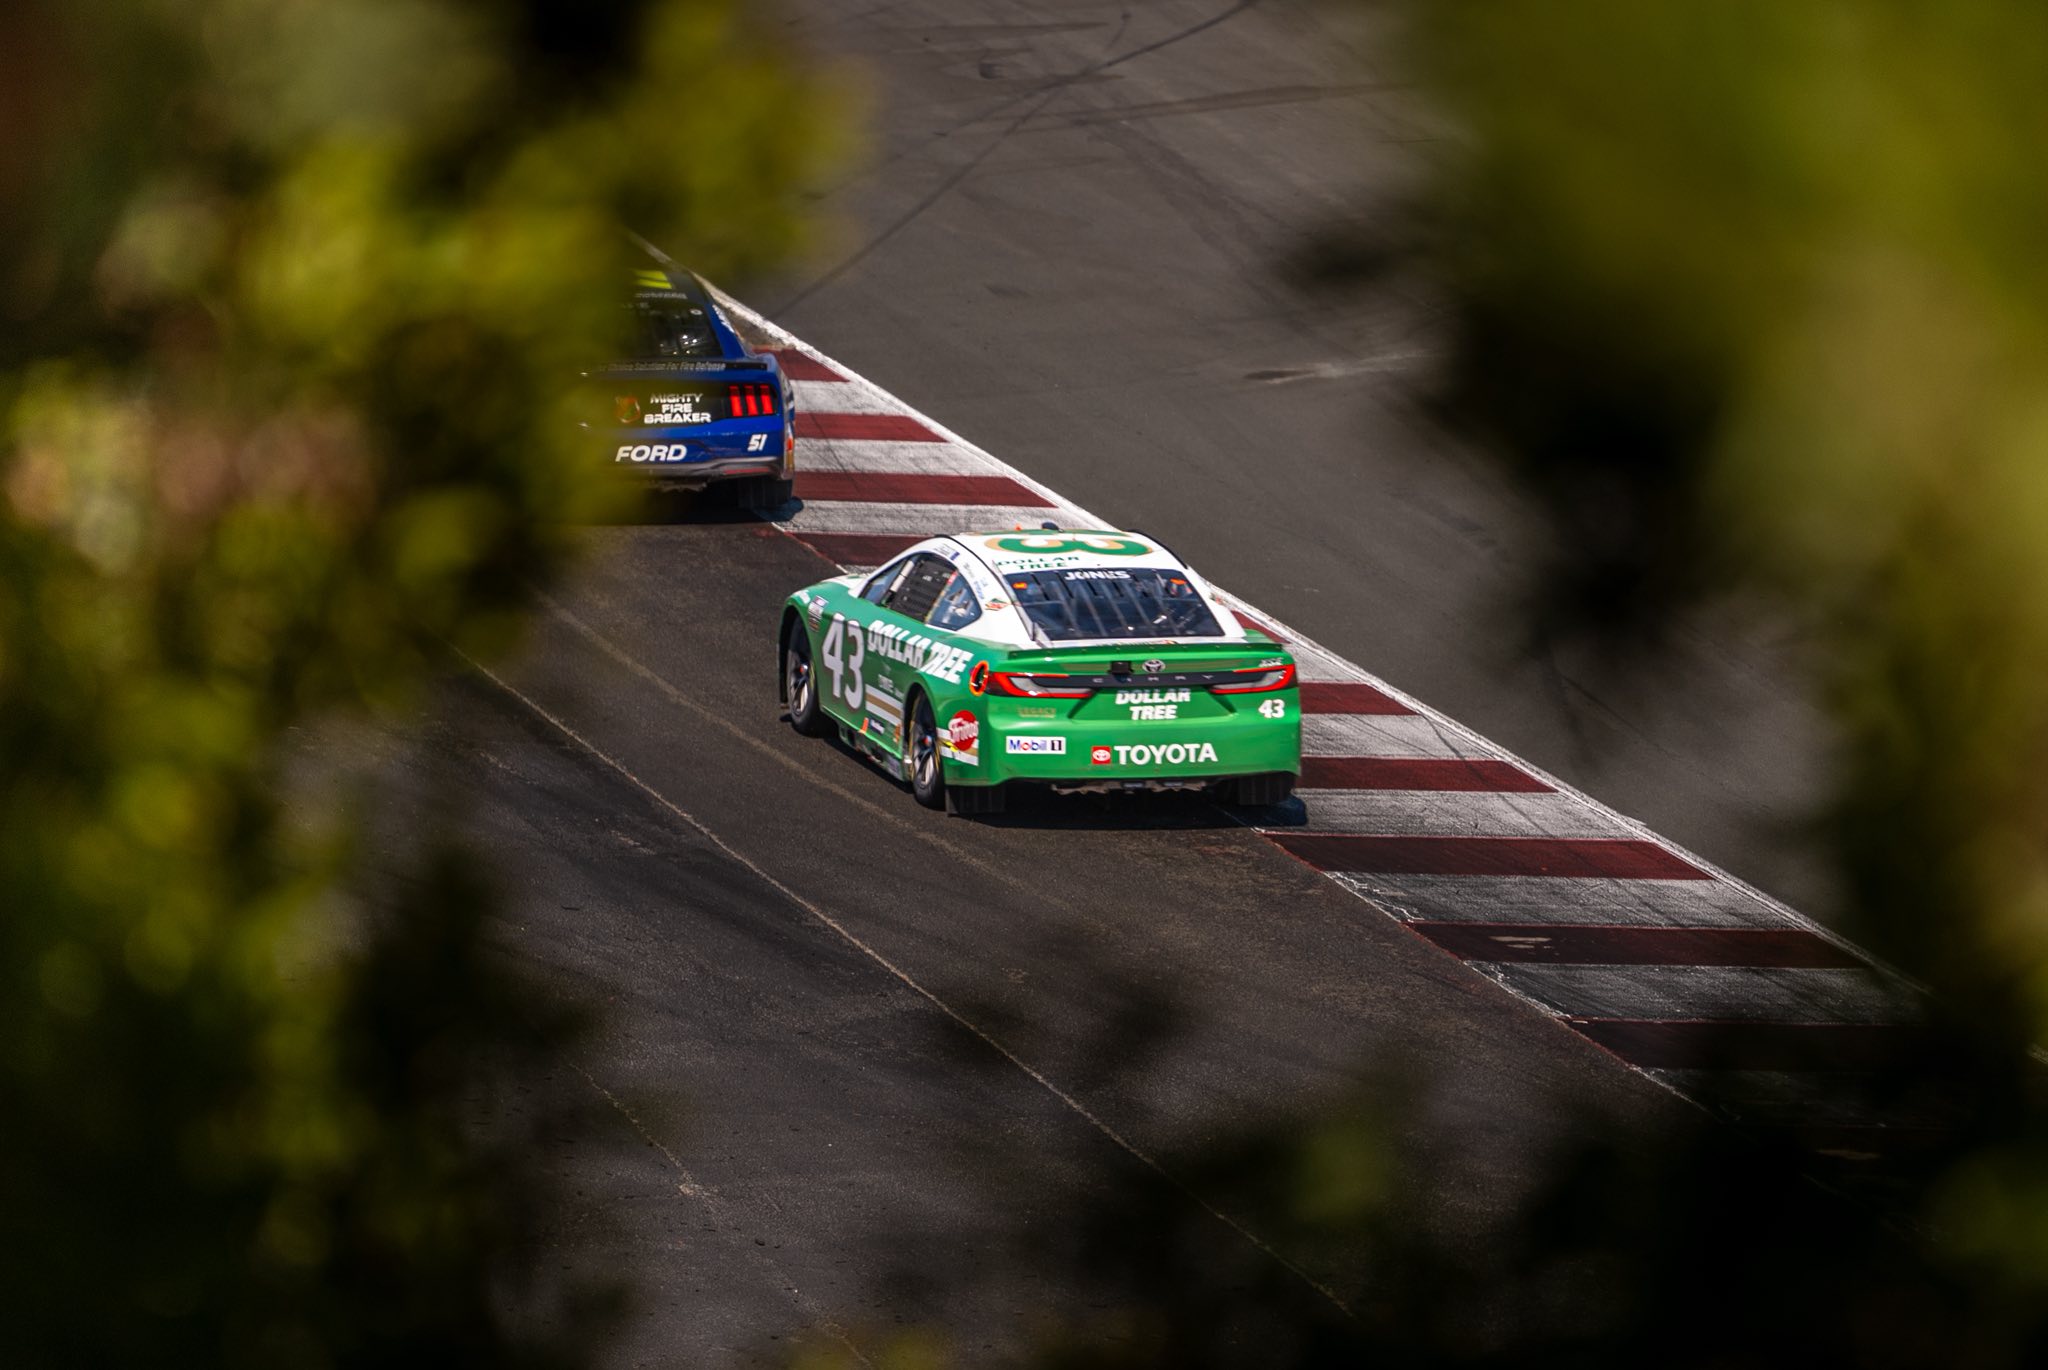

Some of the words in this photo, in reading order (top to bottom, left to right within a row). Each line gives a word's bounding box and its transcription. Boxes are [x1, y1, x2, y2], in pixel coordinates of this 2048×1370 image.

[680, 360, 695, 371] Fire
[696, 360, 726, 372] Defense
[650, 393, 703, 404] MIGHTY
[661, 403, 693, 413] FIRE
[644, 412, 711, 424] BREAKER
[747, 434, 768, 451] 51
[615, 444, 687, 462] FORD
[997, 556, 1080, 567] DOLLAR
[1018, 562, 1068, 570] TREE
[1064, 570, 1131, 581] JONES
[867, 619, 931, 668] DOLLAR
[918, 641, 975, 685] TREE
[822, 612, 865, 710] 43
[1115, 687, 1192, 705] DOLLAR
[1129, 704, 1179, 720] TREE
[1258, 699, 1285, 718] 43
[1009, 739, 1048, 751] Mobil
[1114, 743, 1218, 765] TOYOTA
